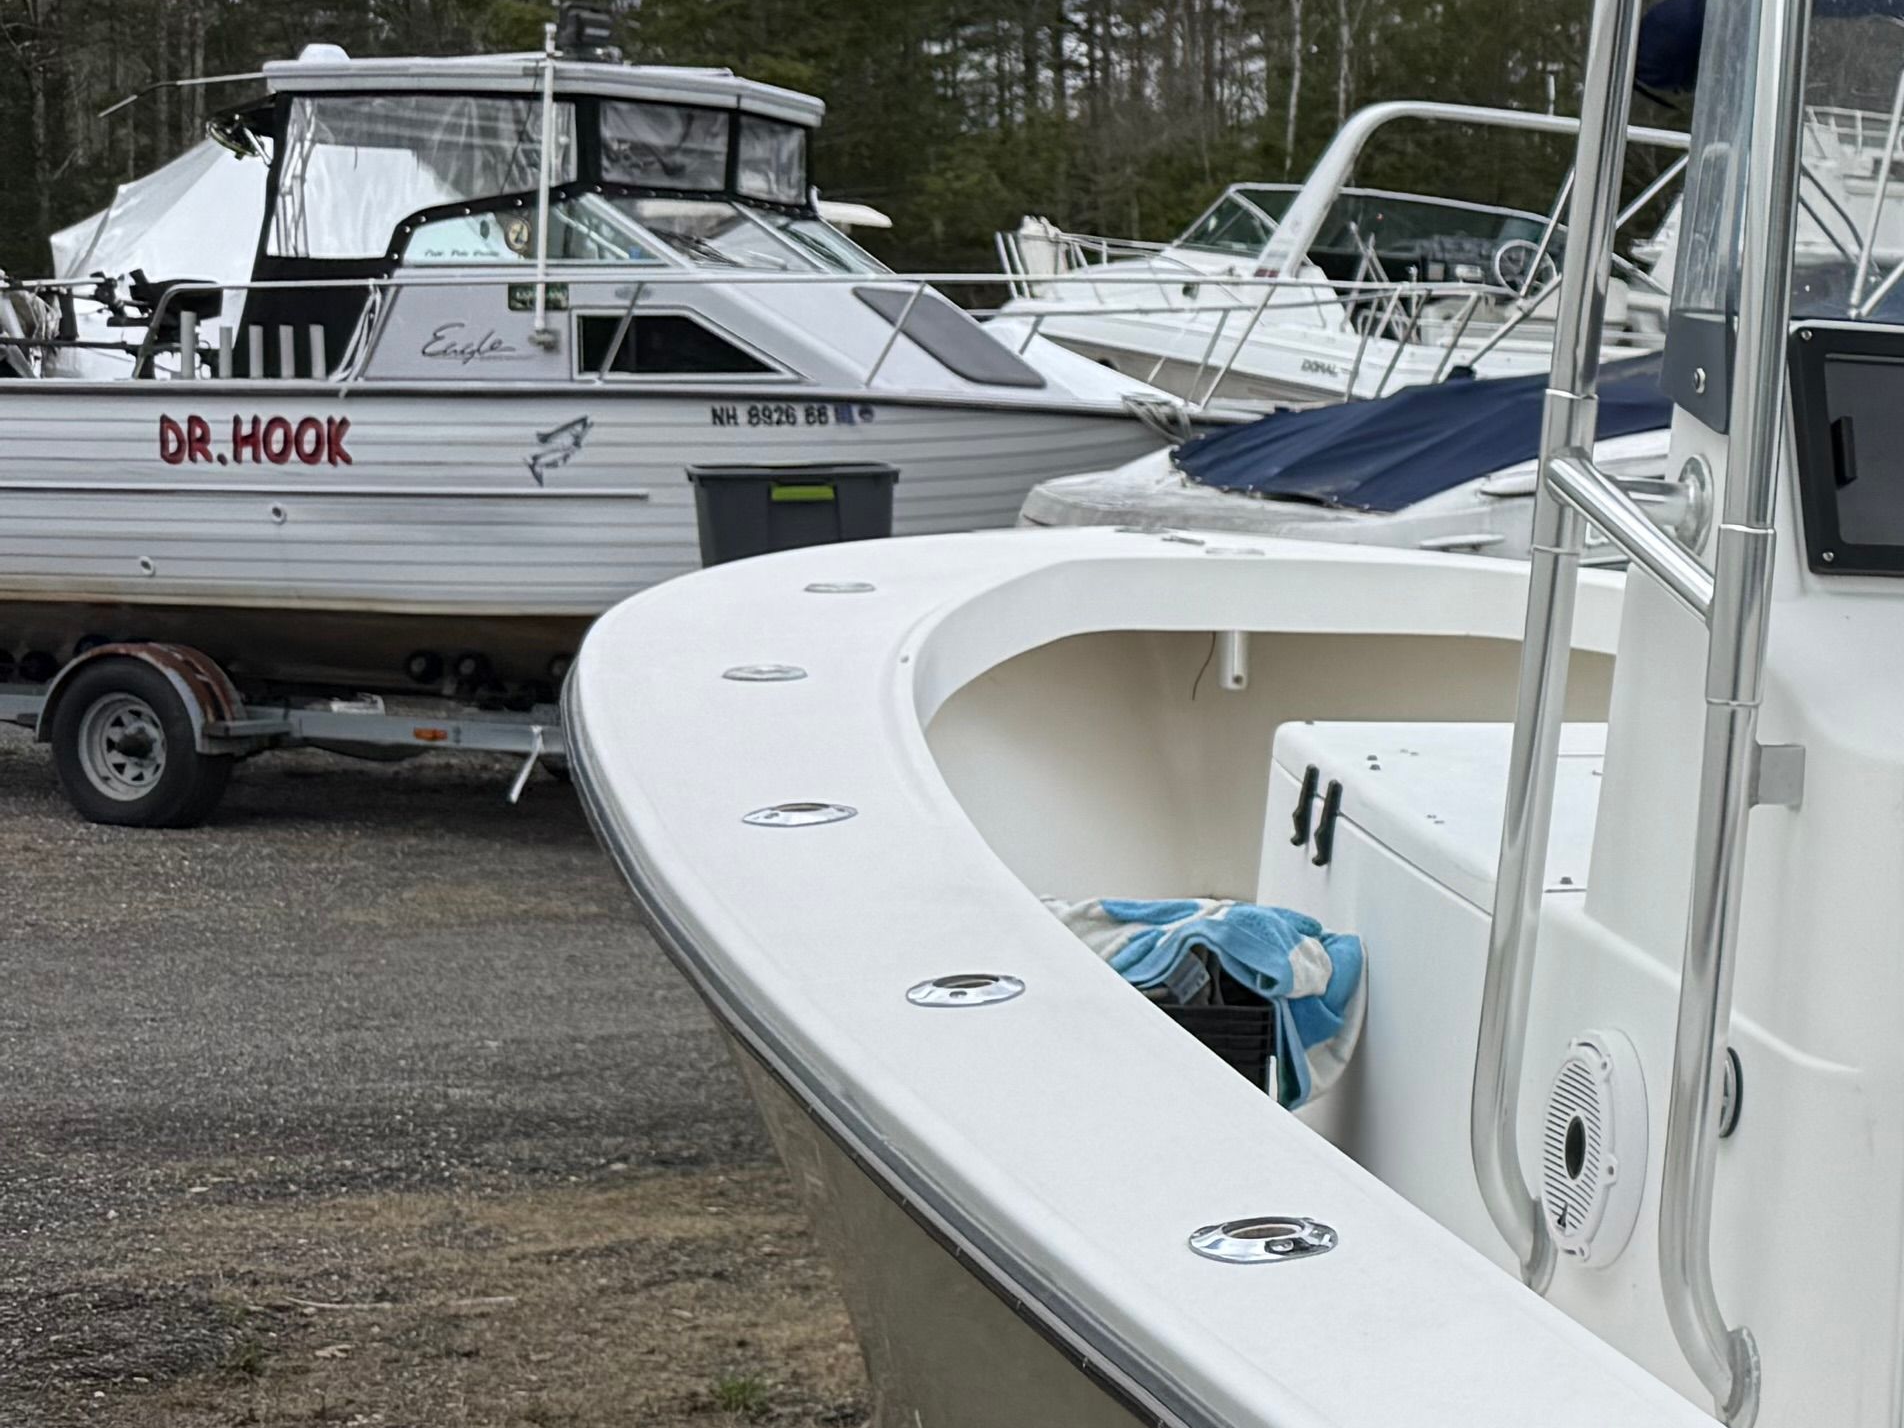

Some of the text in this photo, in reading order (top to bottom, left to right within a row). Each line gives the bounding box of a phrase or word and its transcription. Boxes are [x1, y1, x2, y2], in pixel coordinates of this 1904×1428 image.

[711, 404, 739, 426] NH
[159, 413, 353, 467] DR. HOOK
